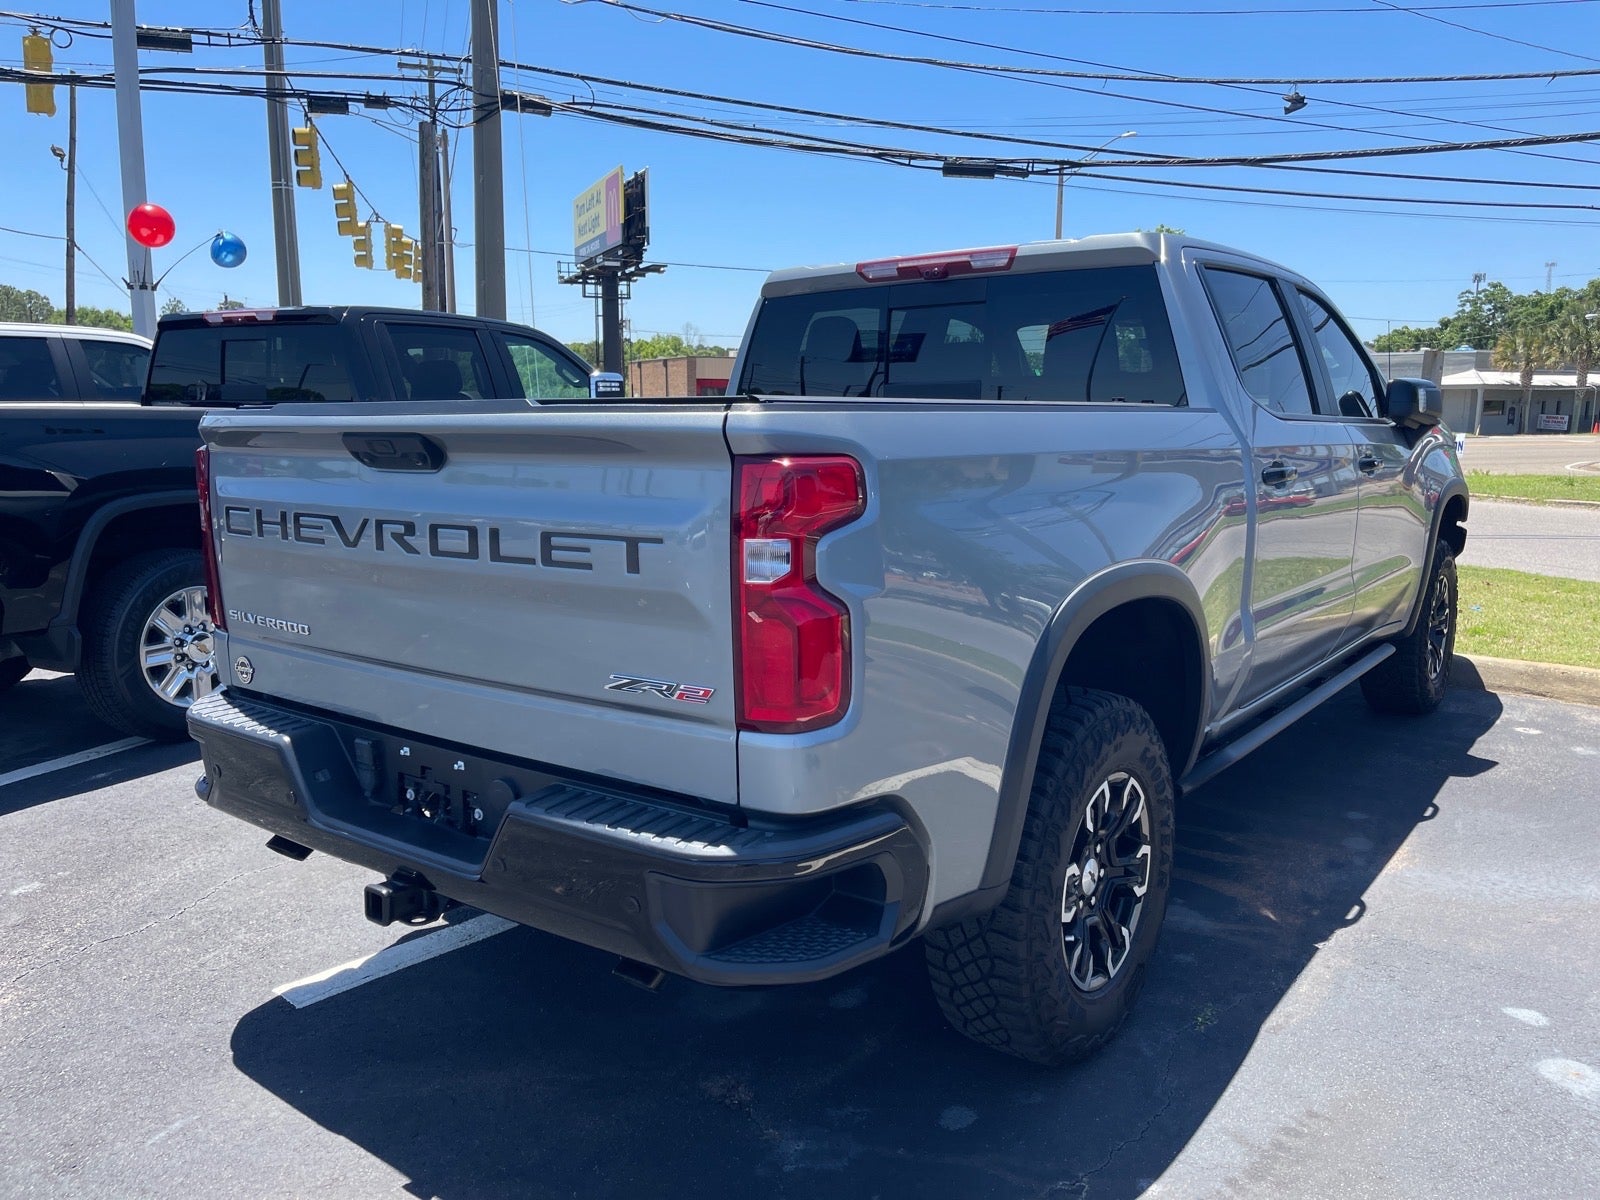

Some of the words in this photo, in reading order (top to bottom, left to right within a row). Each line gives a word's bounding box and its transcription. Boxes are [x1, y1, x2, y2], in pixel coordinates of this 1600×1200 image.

[576, 202, 586, 217] Turn
[586, 192, 595, 213] Left
[595, 187, 602, 206] At
[588, 211, 600, 234] Light
[224, 505, 664, 575] CHEVROLET
[228, 609, 310, 636] SILVERADO
[603, 672, 716, 705] ZR2
